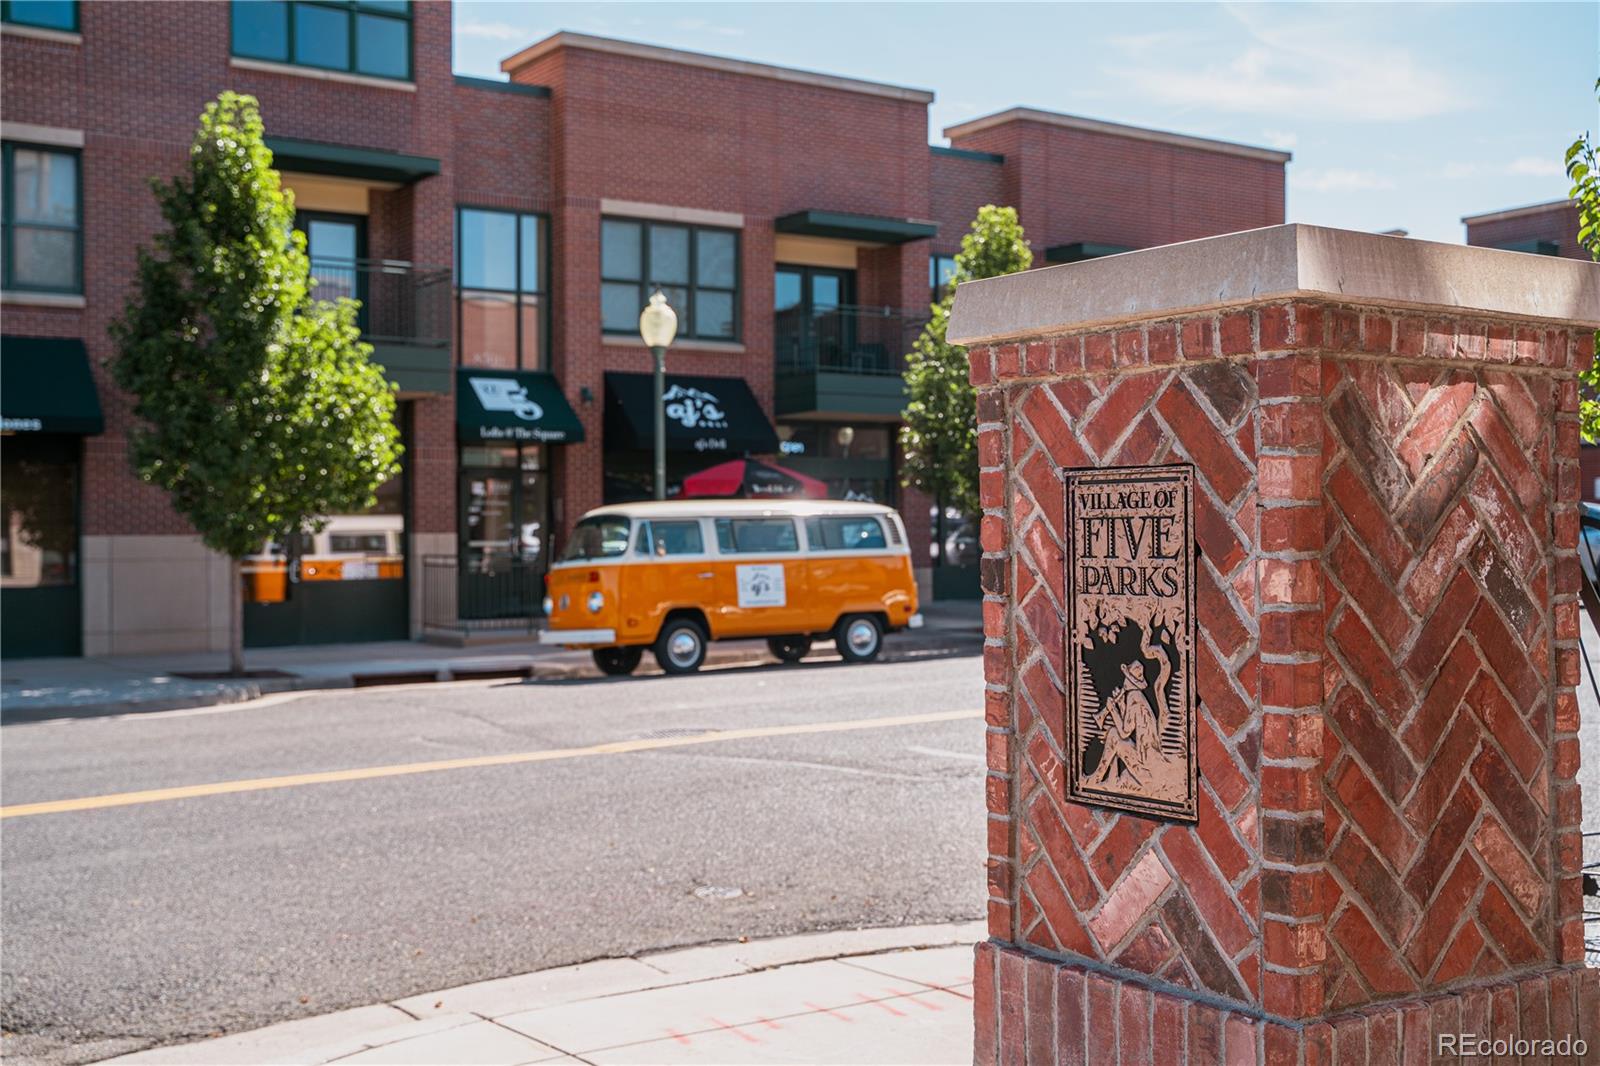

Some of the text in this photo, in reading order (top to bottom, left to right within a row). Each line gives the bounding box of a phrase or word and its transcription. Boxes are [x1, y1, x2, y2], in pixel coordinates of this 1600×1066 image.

[515, 427, 531, 439] The
[532, 427, 566, 442] Square
[1079, 489, 1178, 510] VILLAGE OF
[1079, 514, 1182, 561] FIVE
[1079, 565, 1179, 598] PARKS
